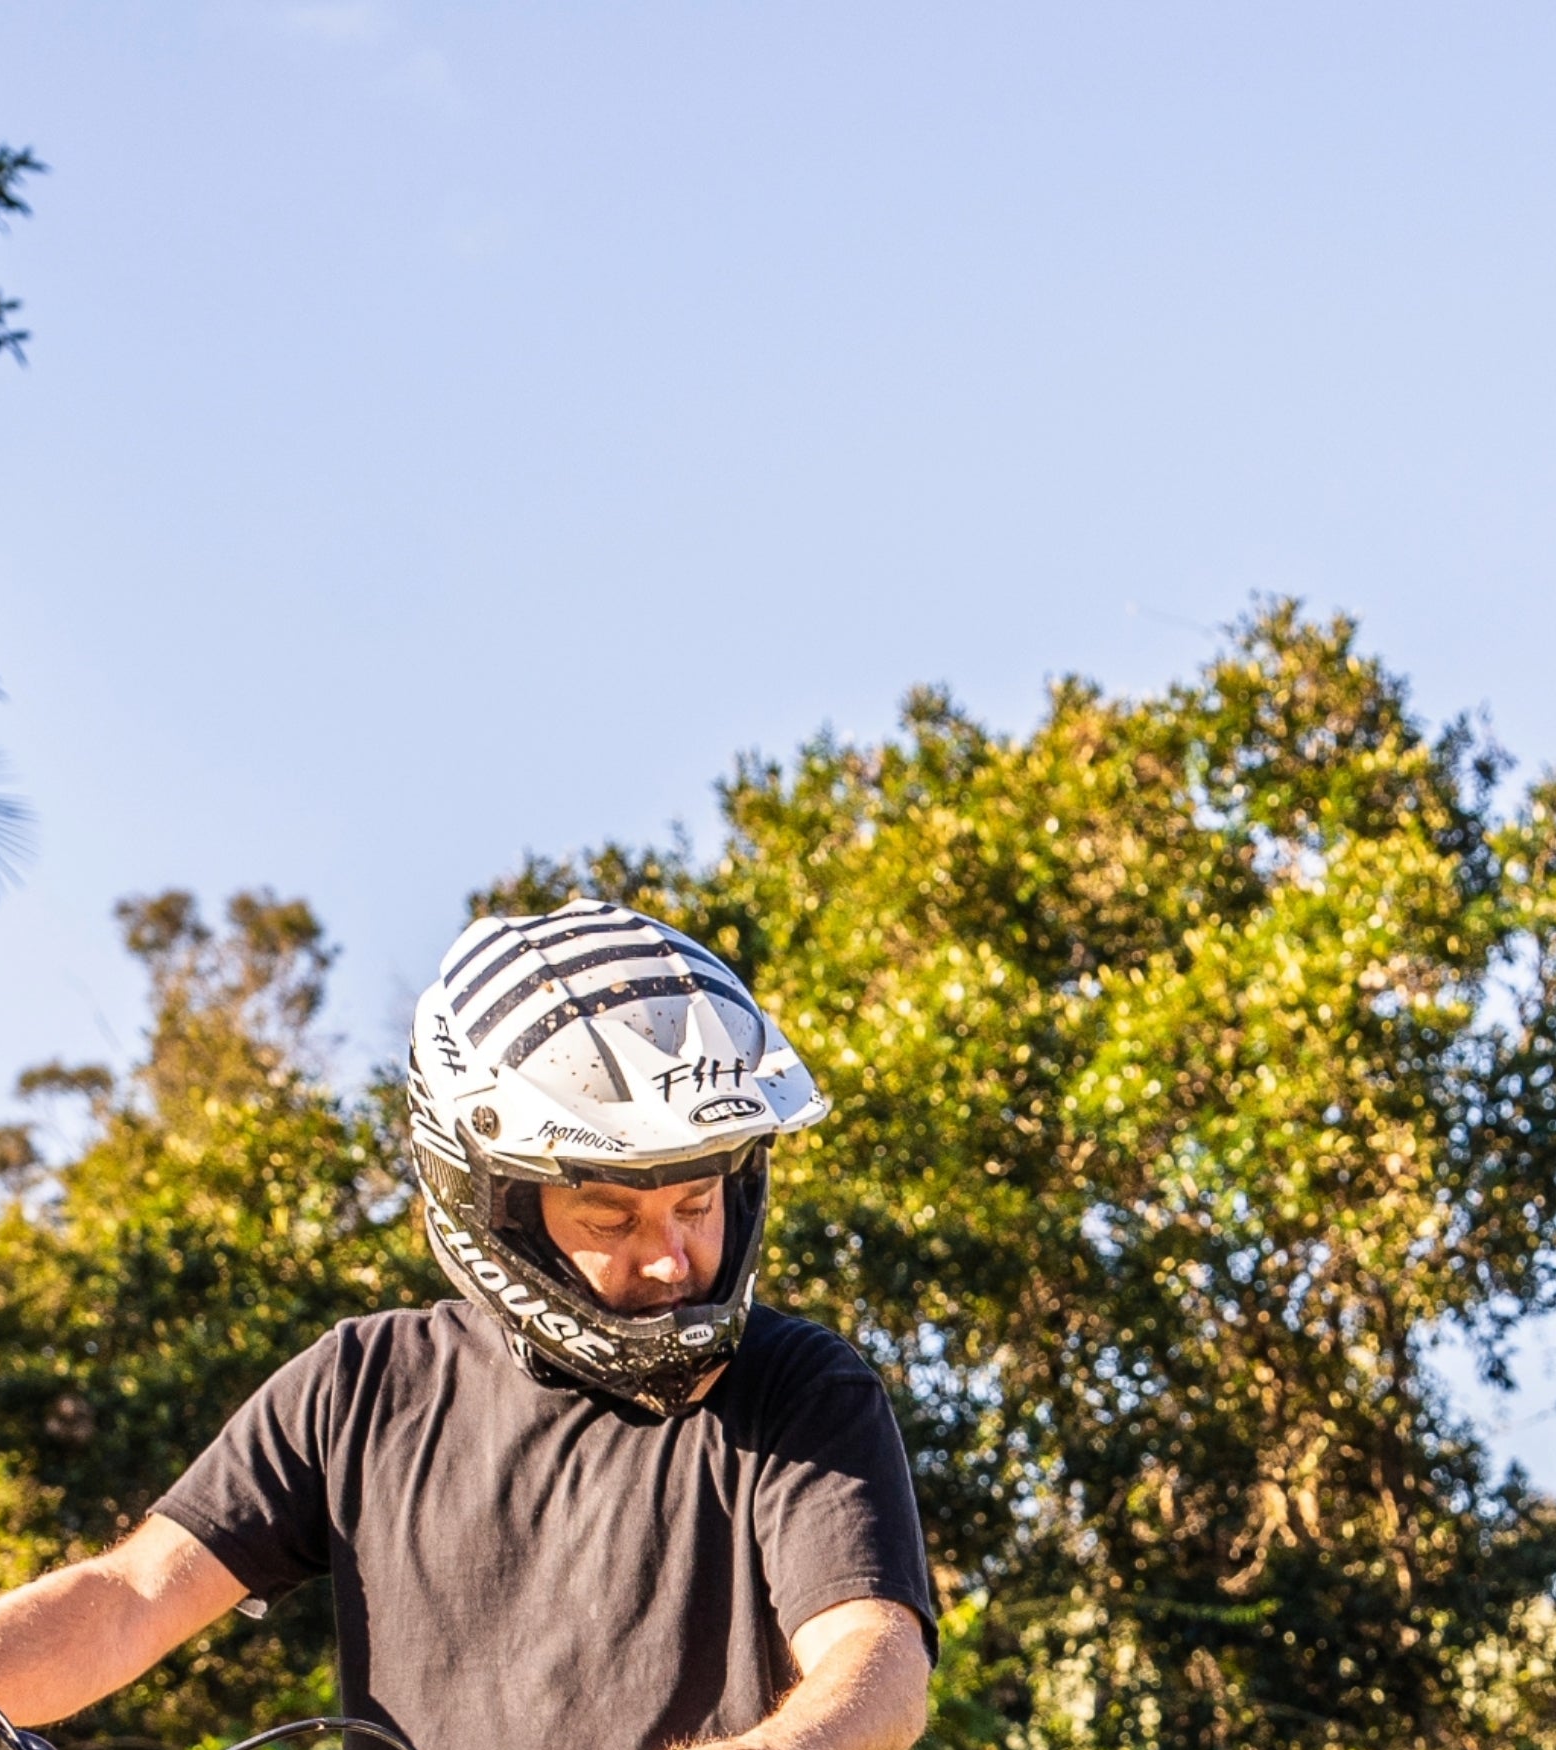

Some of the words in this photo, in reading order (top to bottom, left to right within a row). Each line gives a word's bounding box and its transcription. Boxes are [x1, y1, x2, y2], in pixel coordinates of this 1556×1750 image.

[699, 1100, 757, 1122] BELL
[537, 1120, 634, 1153] FASTHOUSE
[685, 1328, 709, 1341] BELL
